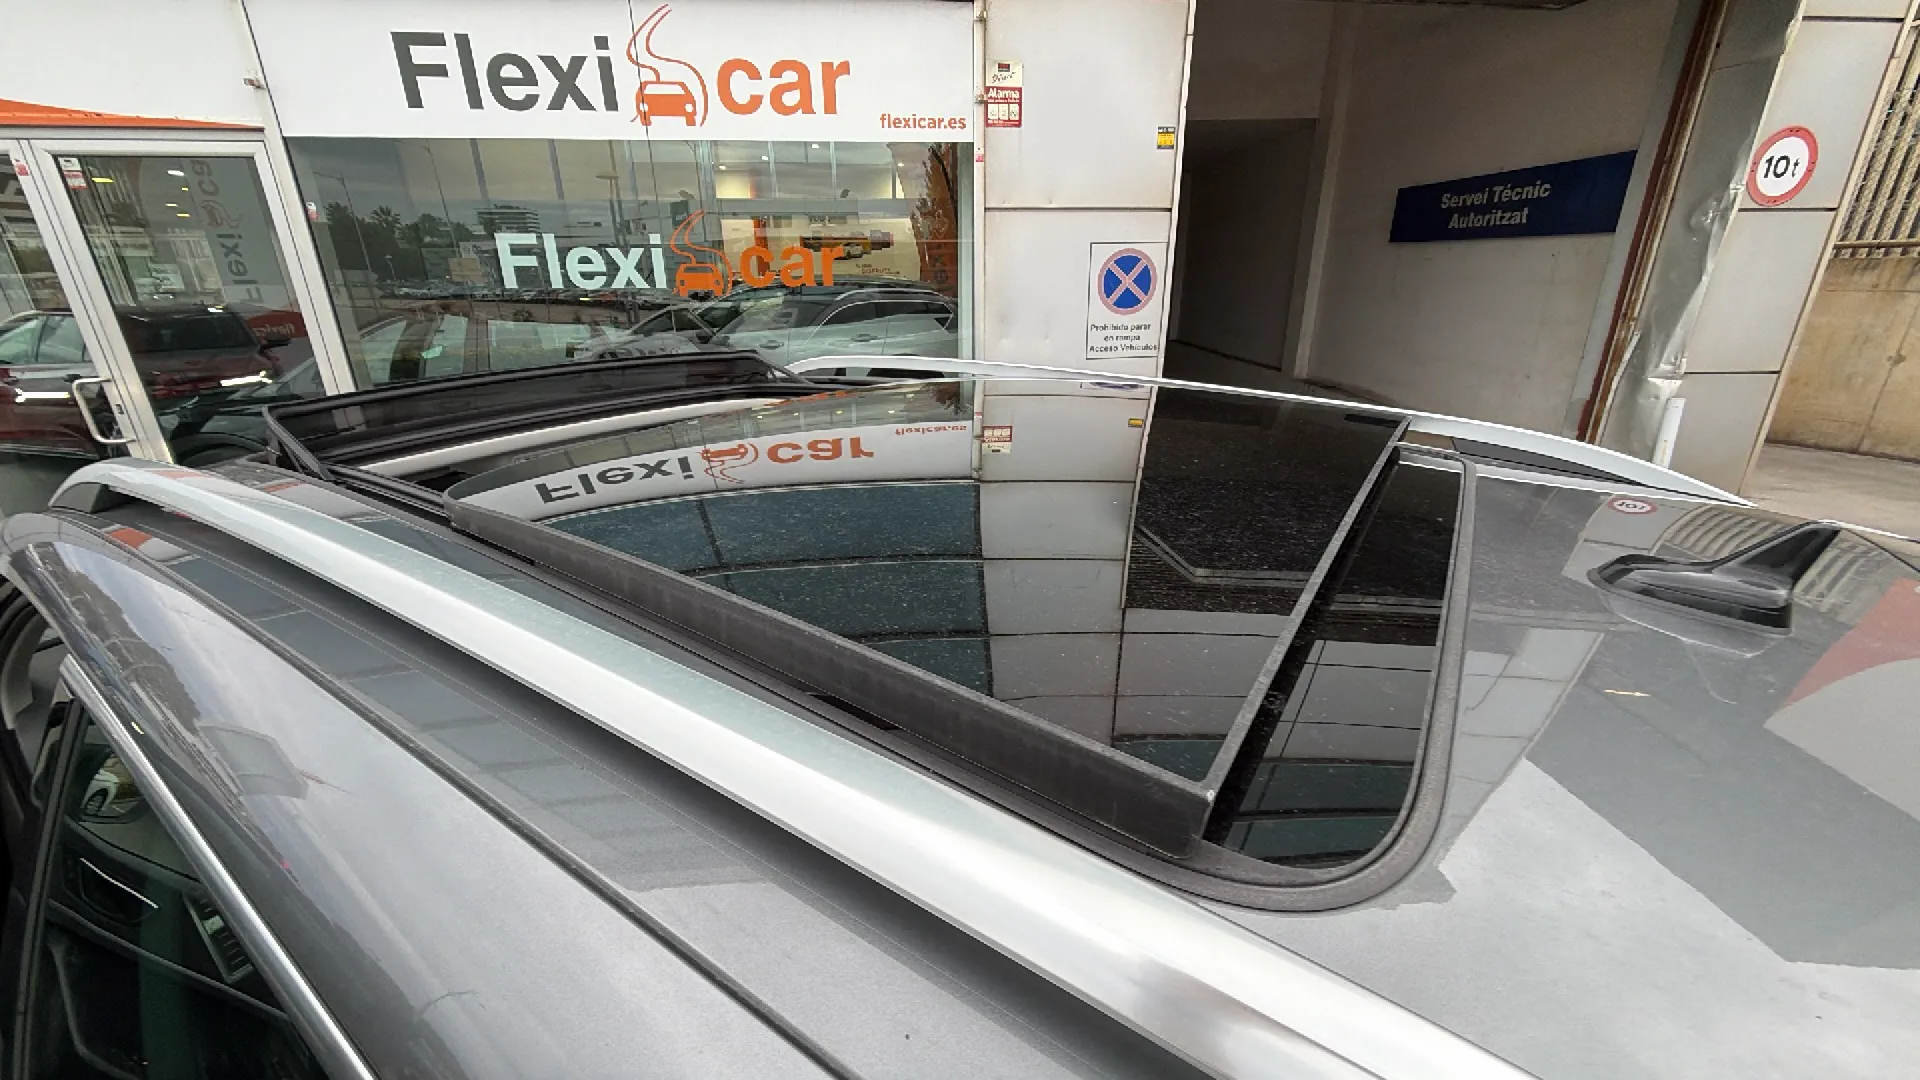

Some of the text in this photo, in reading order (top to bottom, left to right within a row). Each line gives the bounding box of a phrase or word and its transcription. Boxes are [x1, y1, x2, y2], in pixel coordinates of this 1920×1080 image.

[390, 31, 850, 116] Flexi car
[988, 87, 1020, 99] Alarma
[879, 113, 967, 130] flexicar.es
[1763, 155, 1801, 179] 10 t
[1440, 179, 1551, 209] Servei Técnic
[1448, 207, 1529, 229] Autoritzat
[494, 233, 844, 290] Flexi car
[1090, 323, 1151, 332] Prohibido parar
[1089, 345, 1119, 353] Acceso
